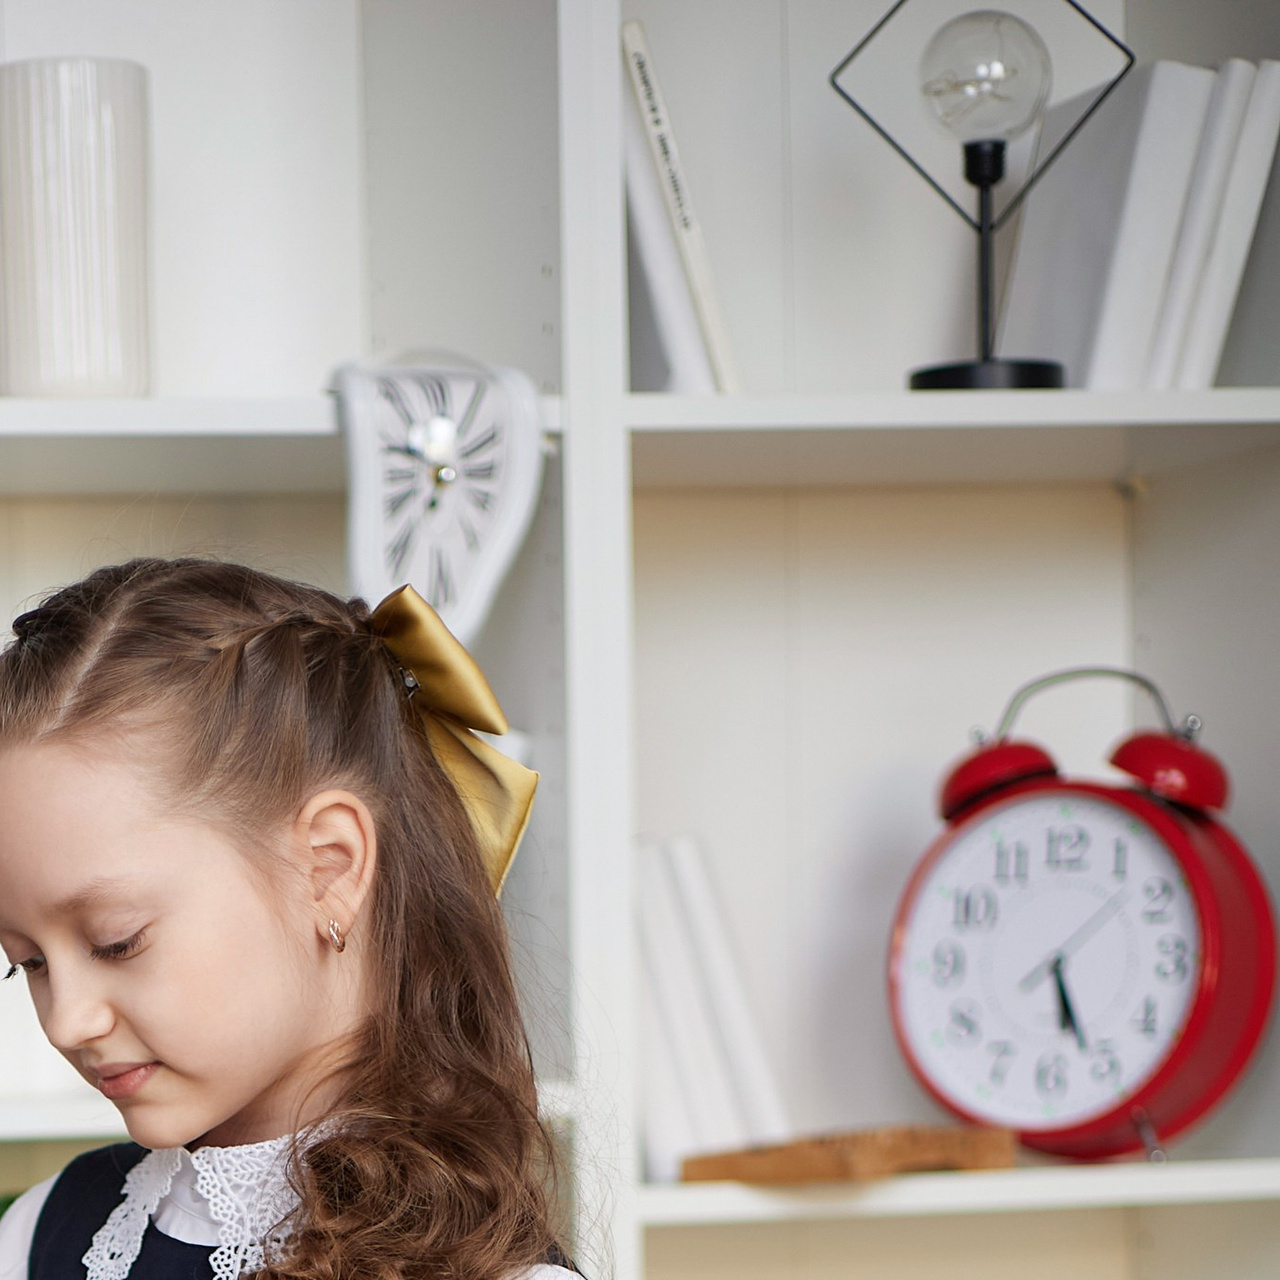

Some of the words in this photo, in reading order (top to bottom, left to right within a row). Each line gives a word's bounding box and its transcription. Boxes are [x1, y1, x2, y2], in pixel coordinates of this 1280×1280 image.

[993, 839, 1030, 889] 11
[1045, 822, 1089, 870] 12
[1111, 837, 1128, 883] 1
[951, 883, 1000, 936] 10
[1140, 876, 1177, 925] 2
[931, 936, 967, 993] 9
[1155, 932, 1189, 987] 3
[1127, 993, 1159, 1043] 4
[985, 1038, 1019, 1088] 7
[1033, 1047, 1068, 1101] 6
